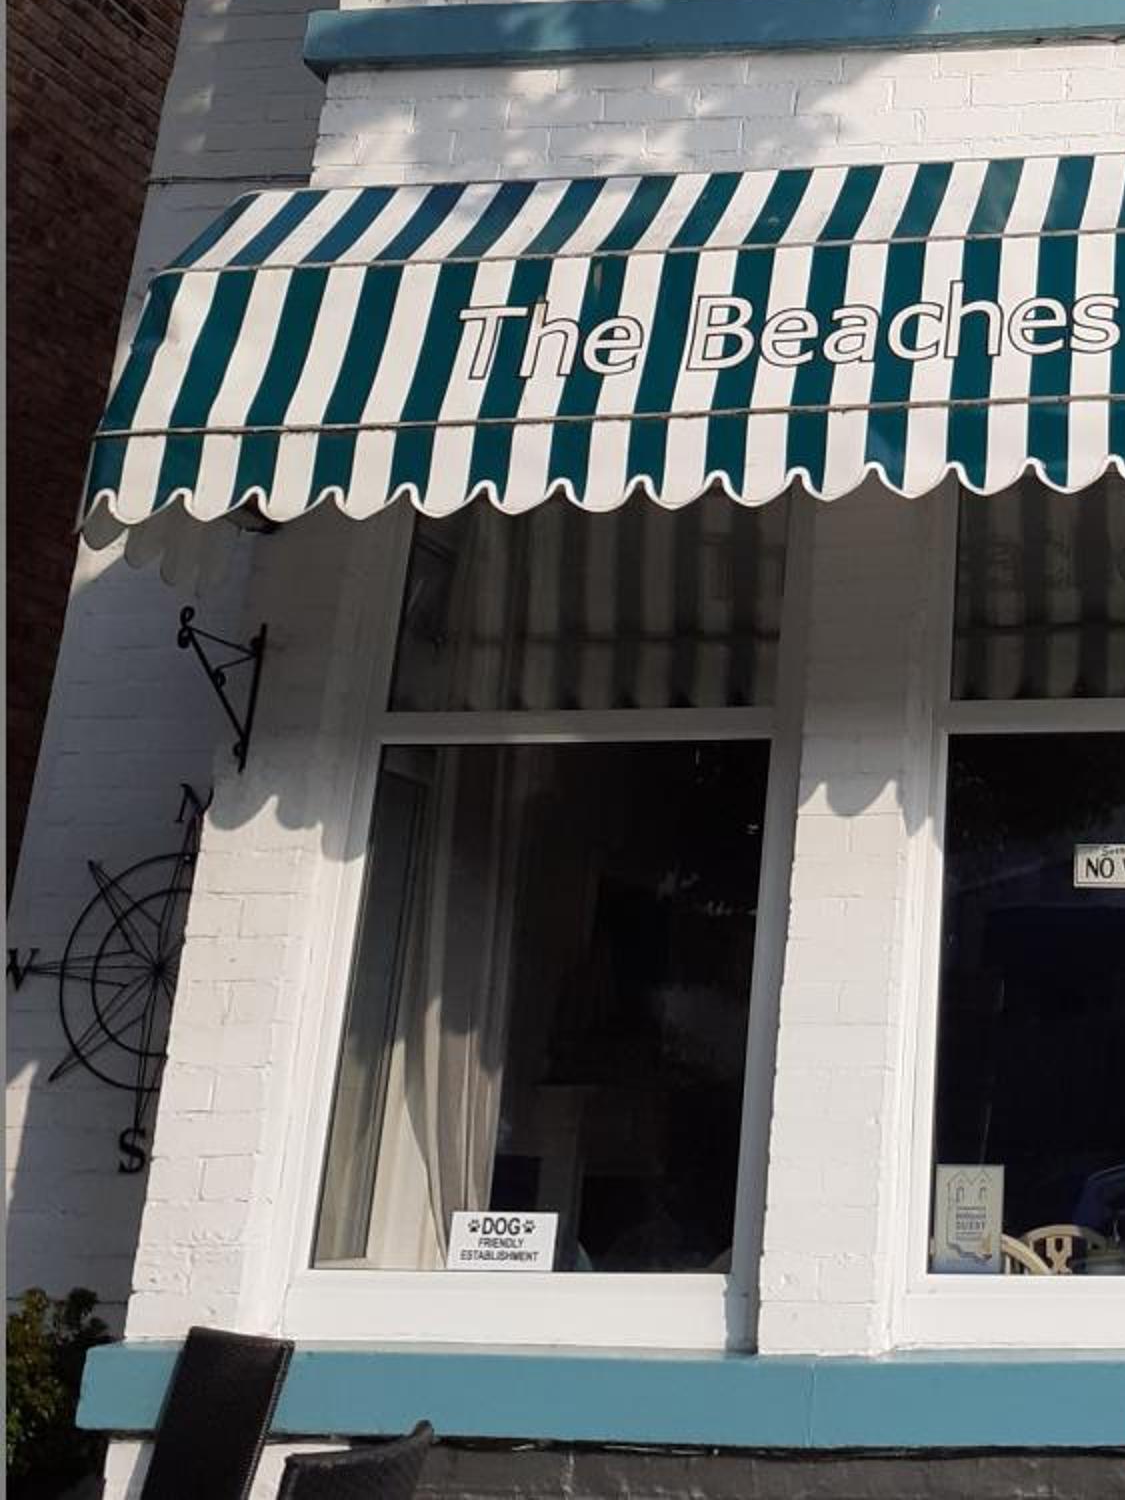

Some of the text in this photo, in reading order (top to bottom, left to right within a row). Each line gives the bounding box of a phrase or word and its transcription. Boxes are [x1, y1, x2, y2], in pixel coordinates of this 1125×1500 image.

[459, 280, 1121, 380] The Beaches
[1086, 857, 1114, 878] NO
[482, 1217, 521, 1235] DOG
[478, 1238, 524, 1248] FRIENDLY
[460, 1249, 539, 1261] ESTABLISHMENT
